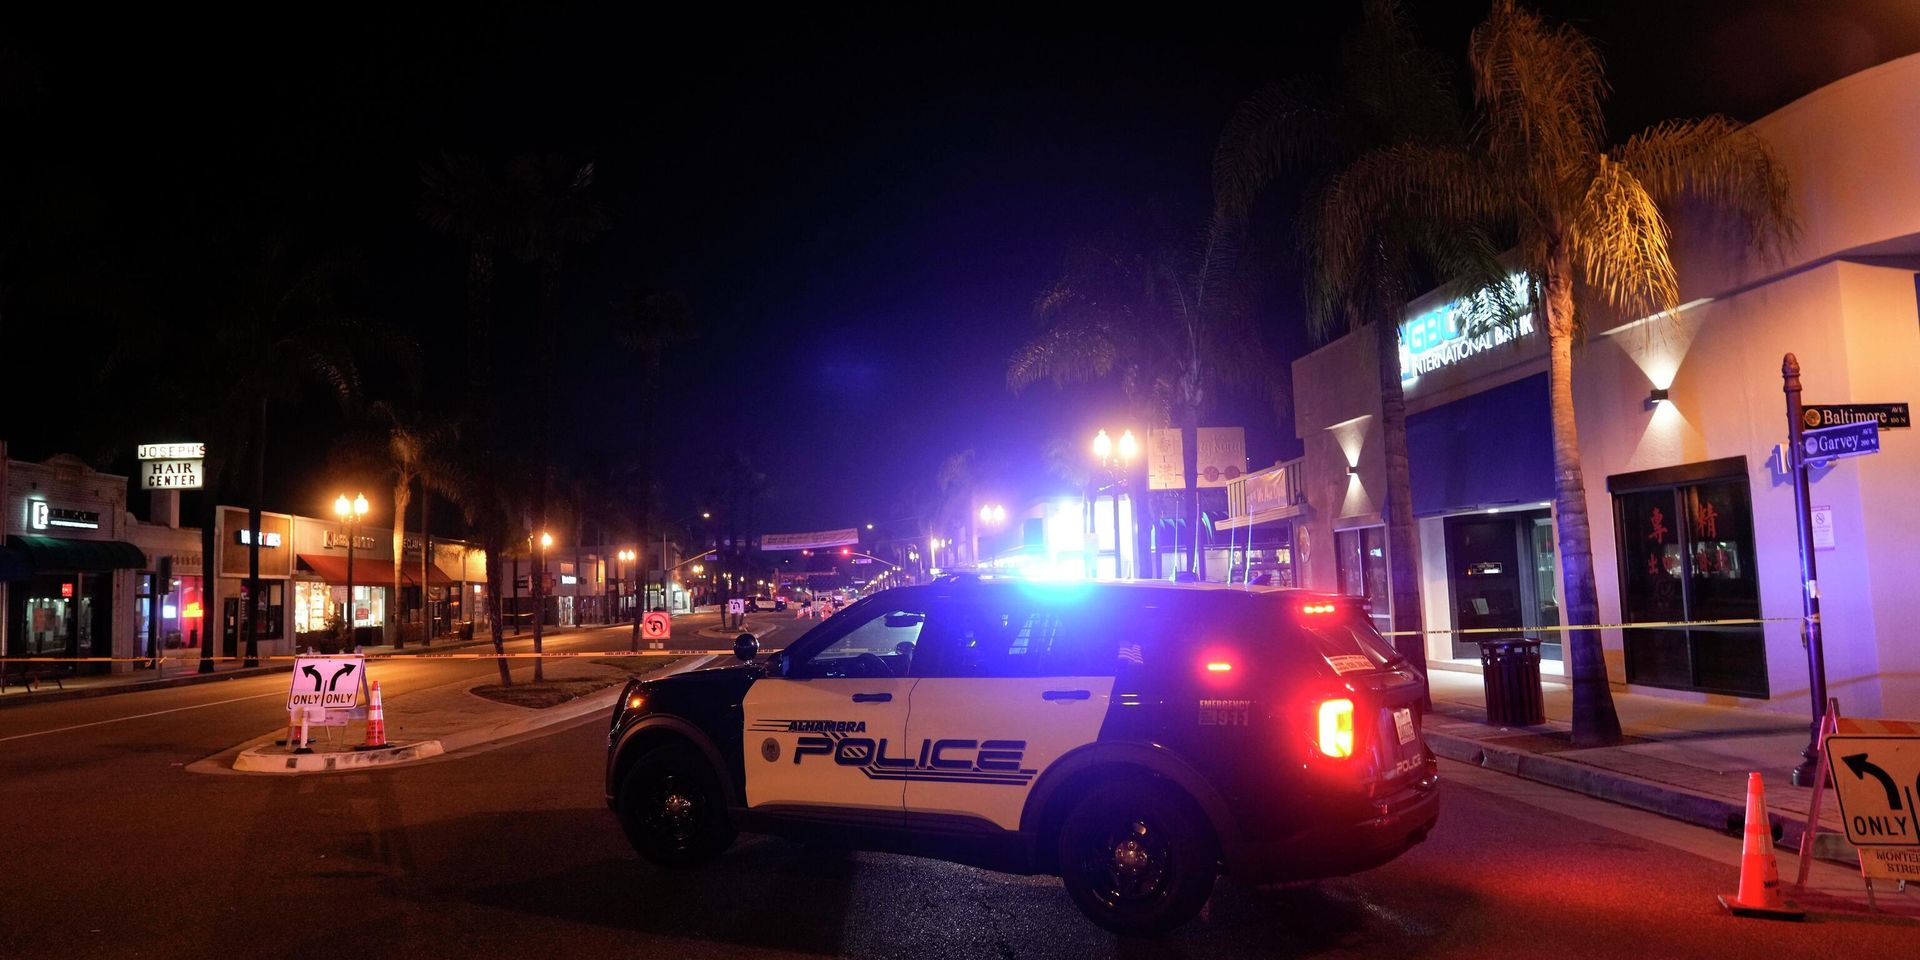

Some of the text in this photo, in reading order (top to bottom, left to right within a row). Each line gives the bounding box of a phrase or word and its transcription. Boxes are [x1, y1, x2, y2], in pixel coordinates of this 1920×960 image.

[1412, 332, 1493, 377] INTERNATIONAL
[1823, 409, 1887, 425] Baltimore
[140, 445, 206, 458] JOSEPH'S
[1818, 435, 1859, 452] Garvey
[152, 463, 192, 474] HAIR
[148, 475, 195, 486] CENTER
[293, 693, 353, 705] ONLY ONLY
[788, 721, 866, 733] ALHAMBRA
[793, 736, 1027, 772] POLICE
[1396, 753, 1422, 774] POLICE
[1853, 815, 1907, 836] ONLY
